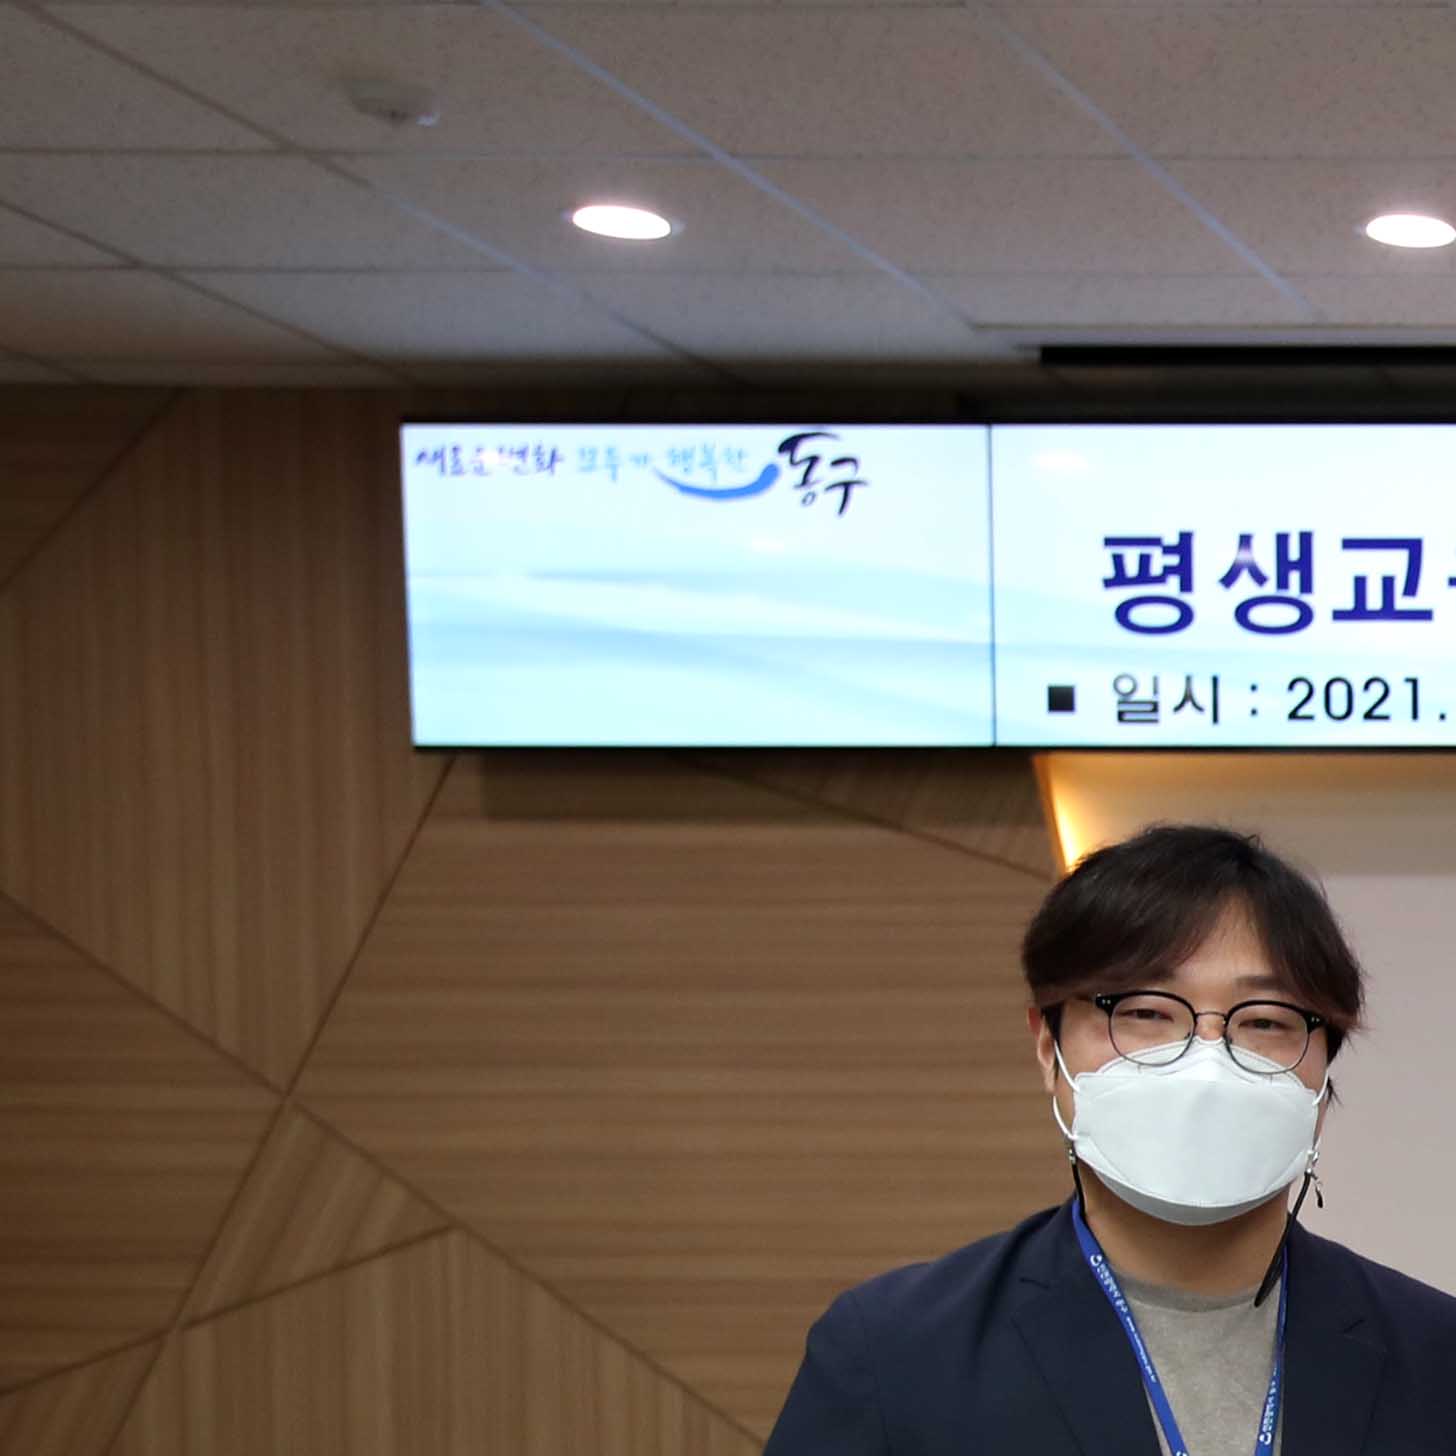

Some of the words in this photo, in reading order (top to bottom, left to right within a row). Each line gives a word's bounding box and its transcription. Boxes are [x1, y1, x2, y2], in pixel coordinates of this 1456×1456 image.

[777, 431, 868, 516] 동구
[1111, 673, 1221, 726] 일시
[1286, 675, 1447, 723] 2021.
